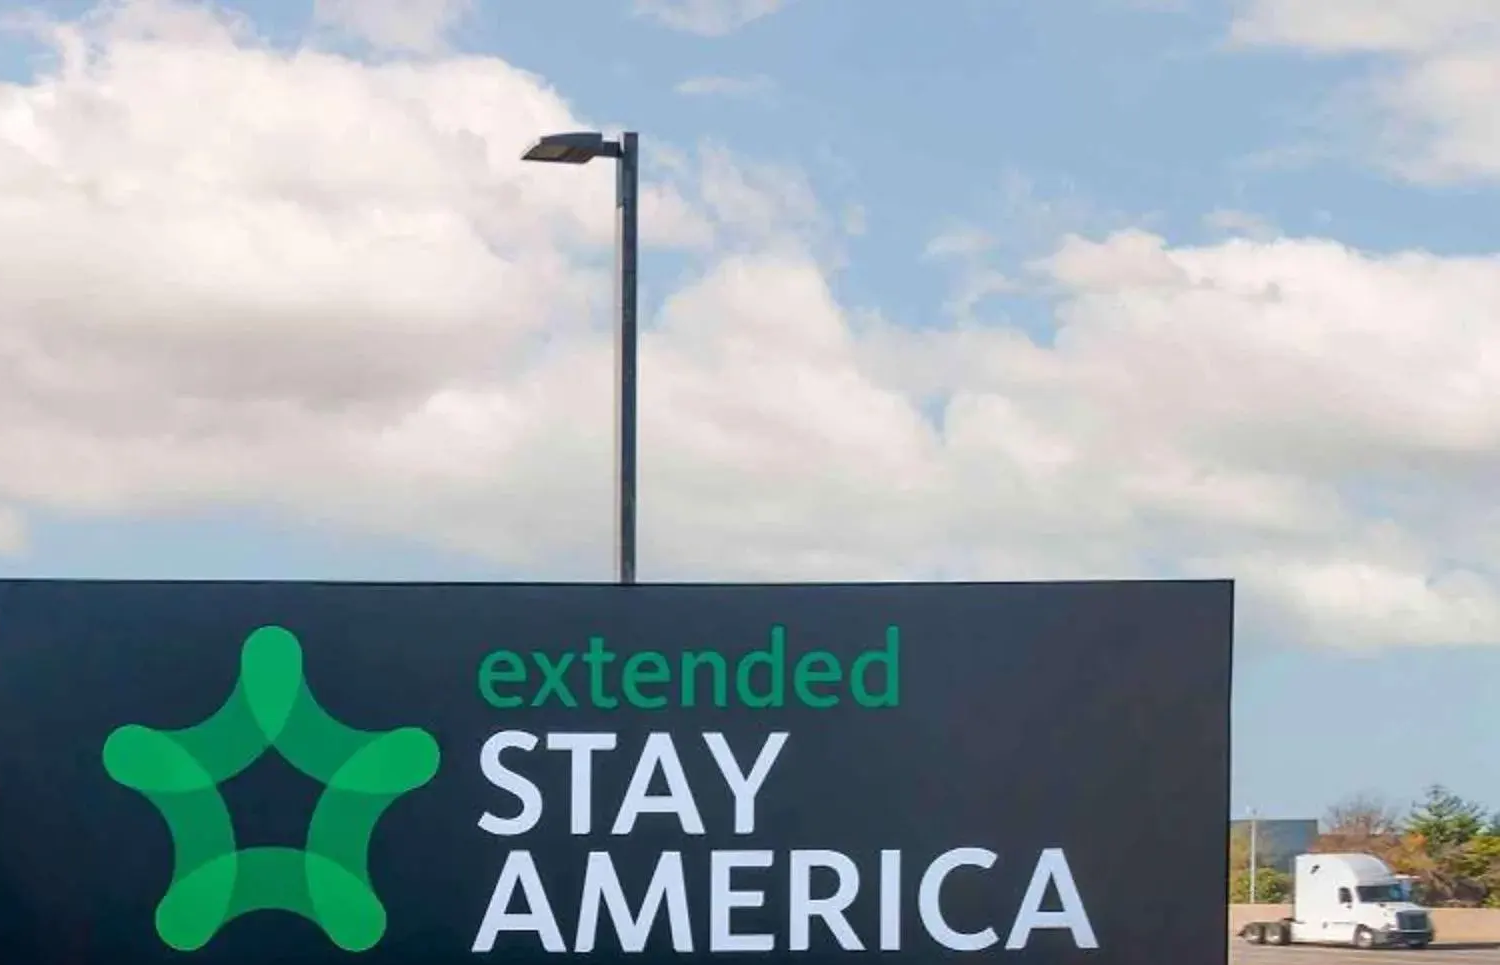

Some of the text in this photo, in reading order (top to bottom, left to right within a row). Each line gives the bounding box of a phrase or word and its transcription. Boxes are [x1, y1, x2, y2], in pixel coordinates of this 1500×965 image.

[477, 625, 901, 709] extended
[477, 730, 790, 836] STAY
[472, 847, 1099, 953] AMERICA
